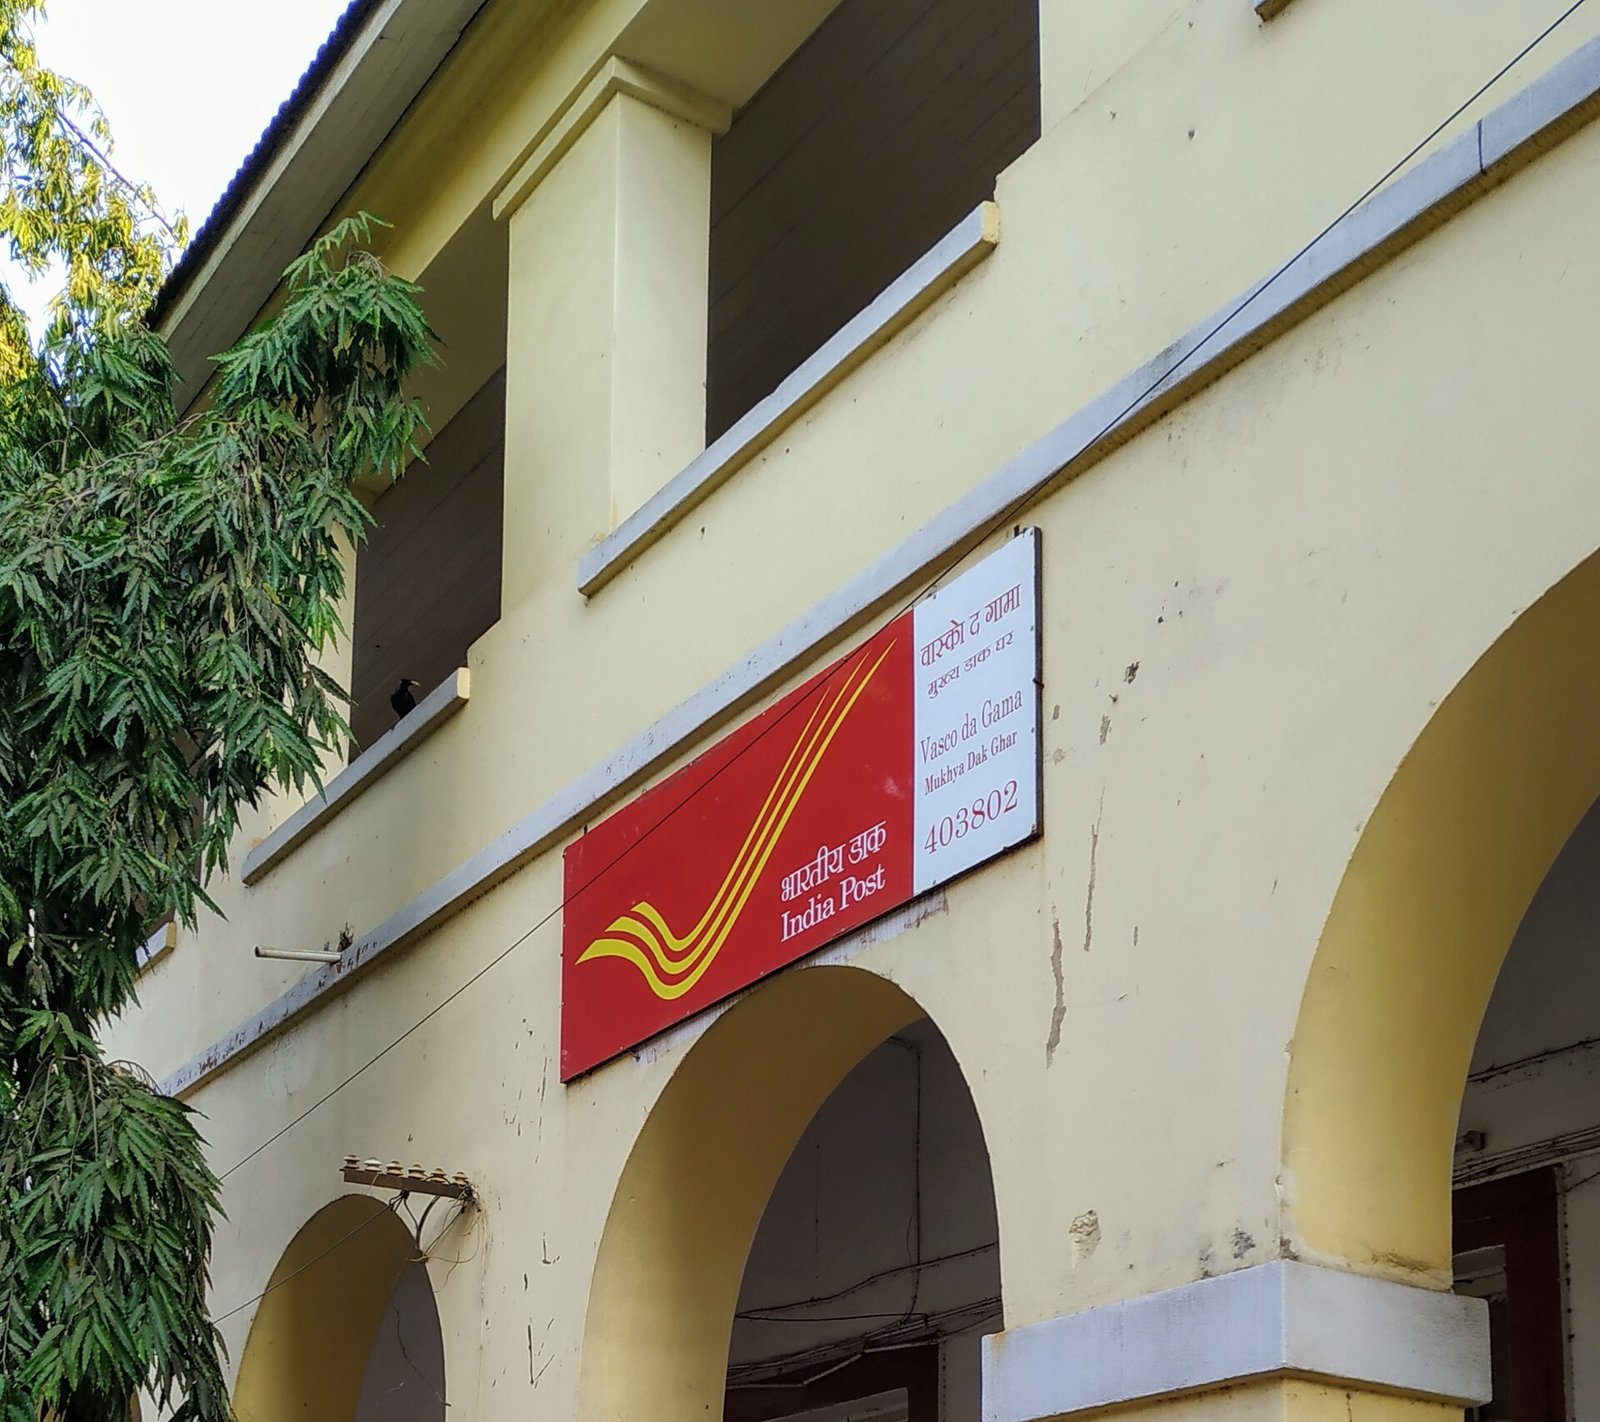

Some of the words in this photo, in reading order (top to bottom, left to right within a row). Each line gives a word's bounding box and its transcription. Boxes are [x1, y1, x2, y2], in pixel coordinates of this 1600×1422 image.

[964, 645, 991, 673] डाक
[995, 630, 1014, 654] घर
[920, 733, 958, 765] Vasco
[961, 712, 977, 741] da
[981, 689, 1023, 728] Gama
[924, 764, 965, 796] Mukhya
[967, 745, 988, 771] Dak
[990, 730, 1018, 757] Ghar
[923, 779, 1019, 854] 403802
[781, 844, 846, 902] भारतीय
[848, 820, 887, 864] डाक
[781, 893, 836, 943] India
[839, 863, 886, 911] Post
